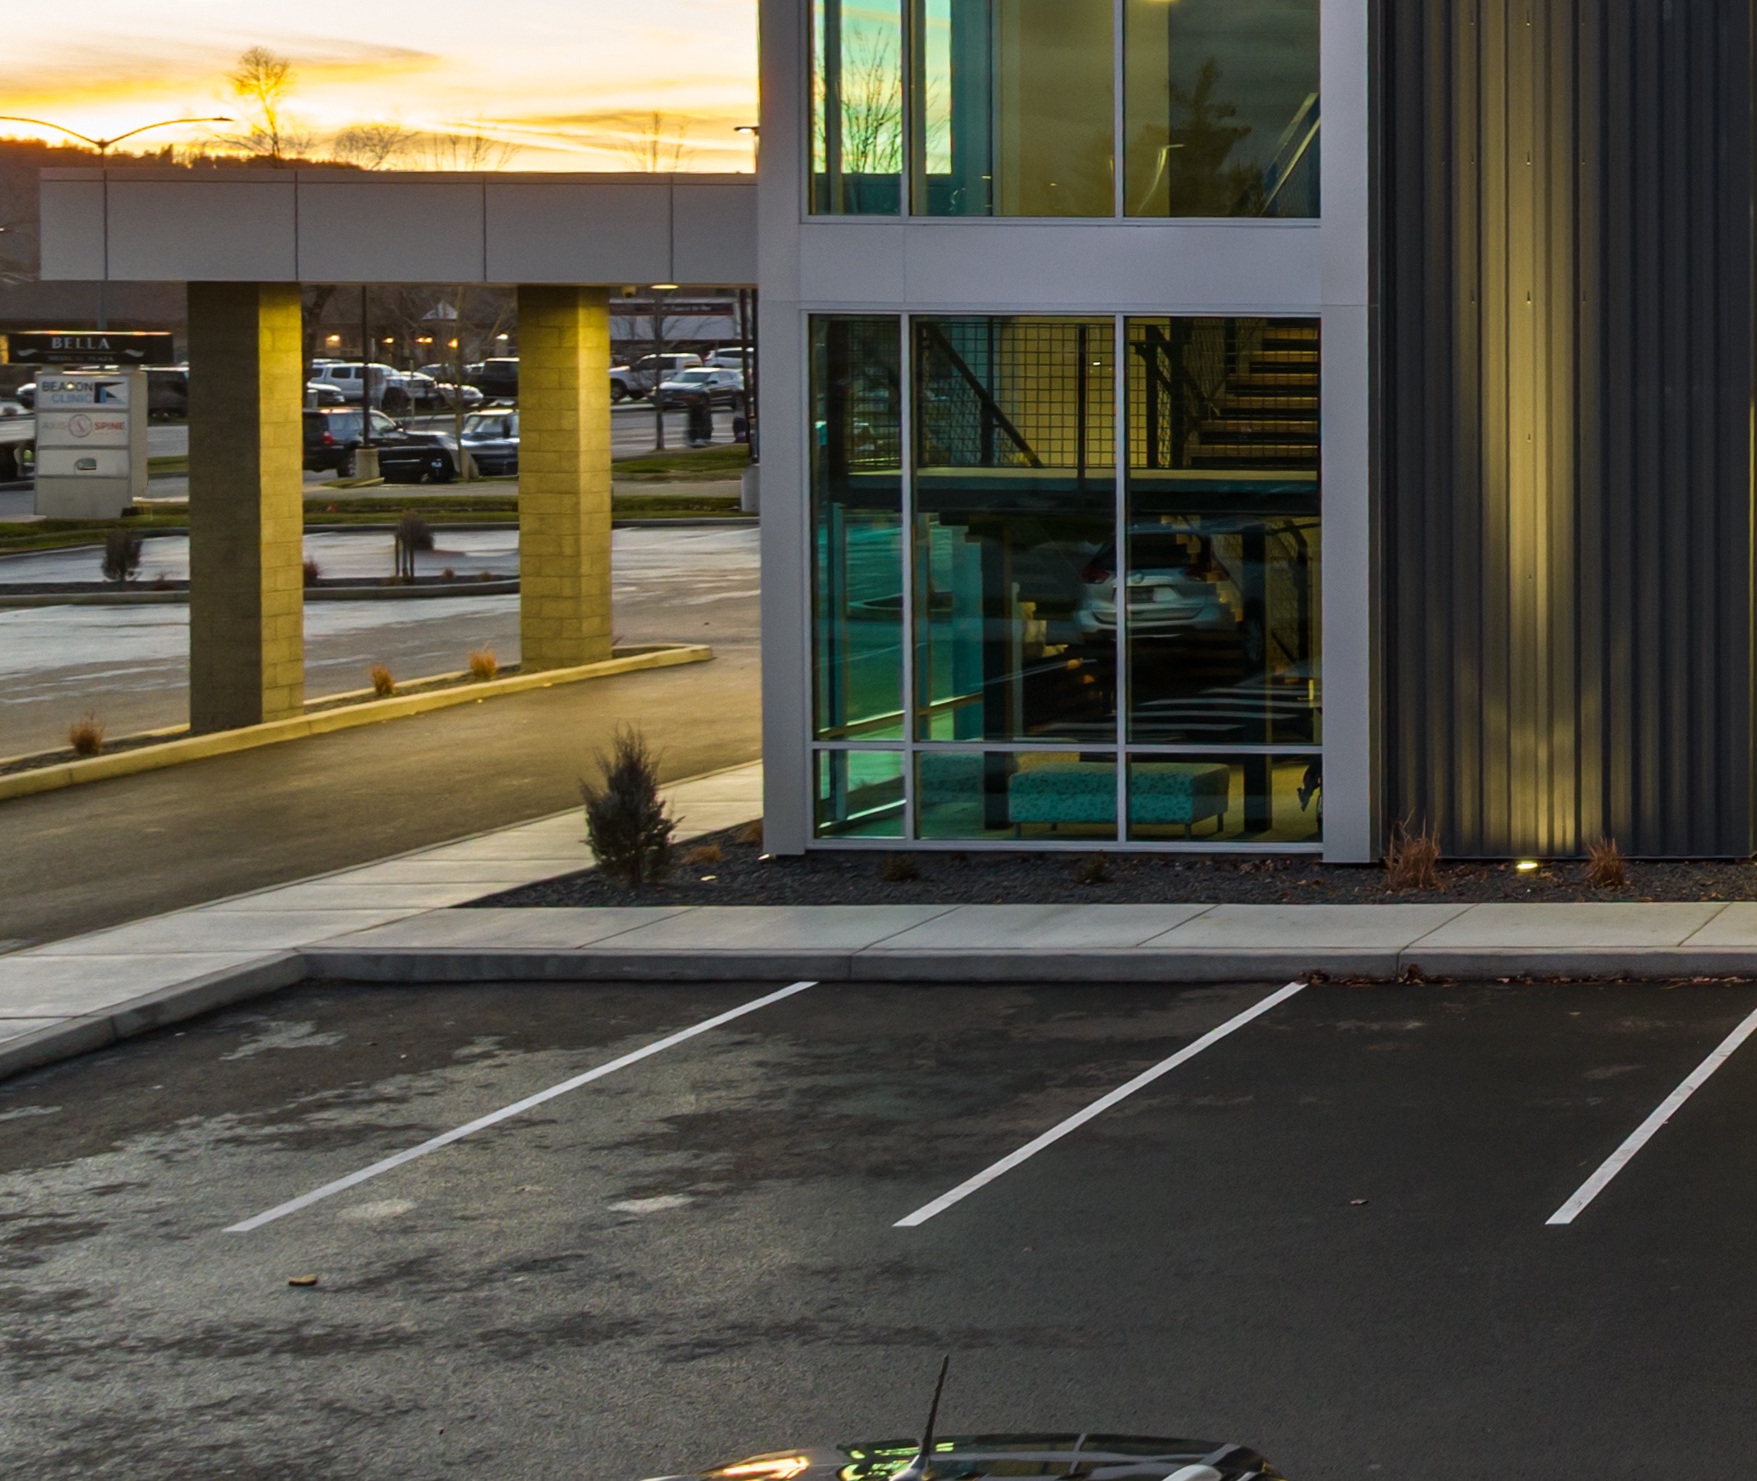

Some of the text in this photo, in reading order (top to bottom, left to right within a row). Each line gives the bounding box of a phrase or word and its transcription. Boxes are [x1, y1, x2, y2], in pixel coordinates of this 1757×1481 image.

[52, 337, 110, 349] BELLA
[52, 393, 94, 404] CLINIC
[94, 421, 125, 430] SPINE
